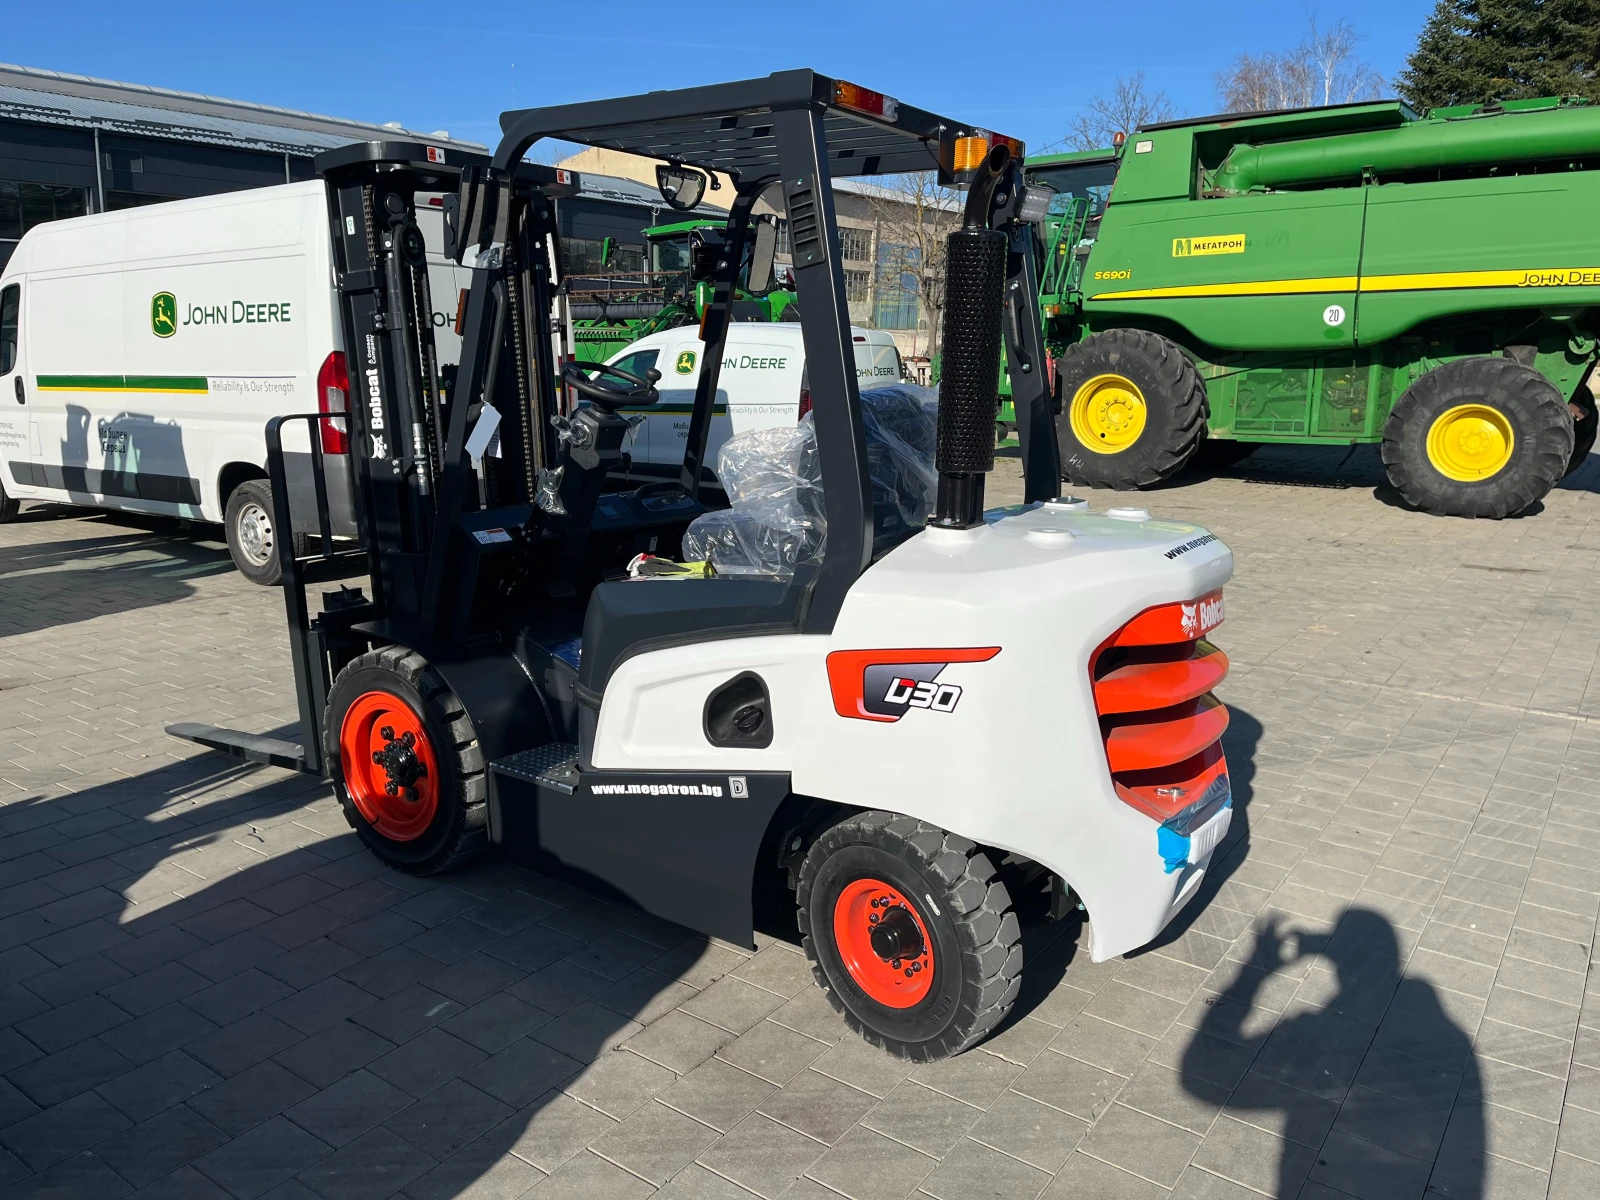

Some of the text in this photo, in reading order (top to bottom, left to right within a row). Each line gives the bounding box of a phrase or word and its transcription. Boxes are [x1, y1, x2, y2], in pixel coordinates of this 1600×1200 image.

[1193, 240, 1242, 251] МЕГАТРОН
[1094, 269, 1132, 280] S690i
[1518, 271, 1600, 285] JOHN DEE
[183, 300, 291, 326] JOHN DEERE
[1328, 309, 1340, 322] 20
[721, 355, 787, 369] HN DEERE
[856, 366, 895, 378] OHN DEERE
[212, 380, 294, 395] Reliability Is Our Strength
[366, 368, 385, 429] Bobcat
[769, 406, 794, 416] Strength
[99, 427, 128, 440] Мобилен
[102, 441, 126, 455] Сервиз
[1199, 598, 1225, 630] Bobca
[883, 676, 963, 713] D30
[590, 783, 723, 797] www.megatron.bg
